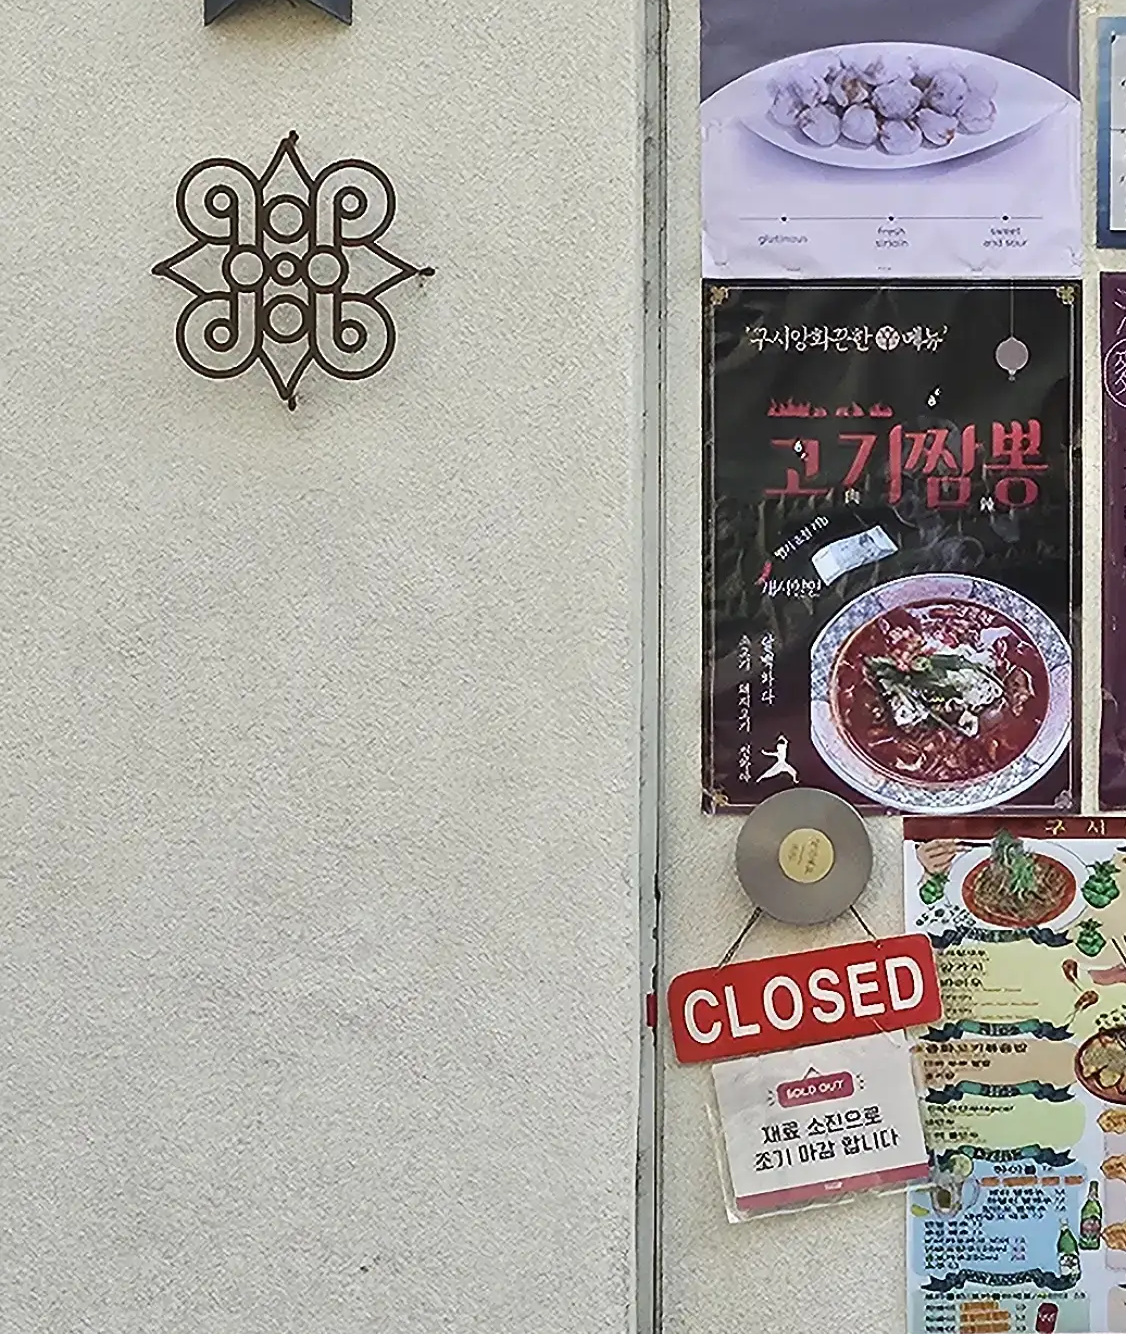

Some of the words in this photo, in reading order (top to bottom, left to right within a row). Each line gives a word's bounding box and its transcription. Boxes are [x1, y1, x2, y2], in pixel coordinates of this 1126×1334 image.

[764, 417, 1049, 511] 고기짬뽕
[684, 955, 925, 1046] CLOSED
[786, 1084, 817, 1100] SOLD
[818, 1079, 844, 1094] OUT
[760, 1121, 801, 1145] 재료
[806, 1105, 883, 1137] 소진으로
[755, 1148, 793, 1172] 조기
[798, 1141, 836, 1164] 마감
